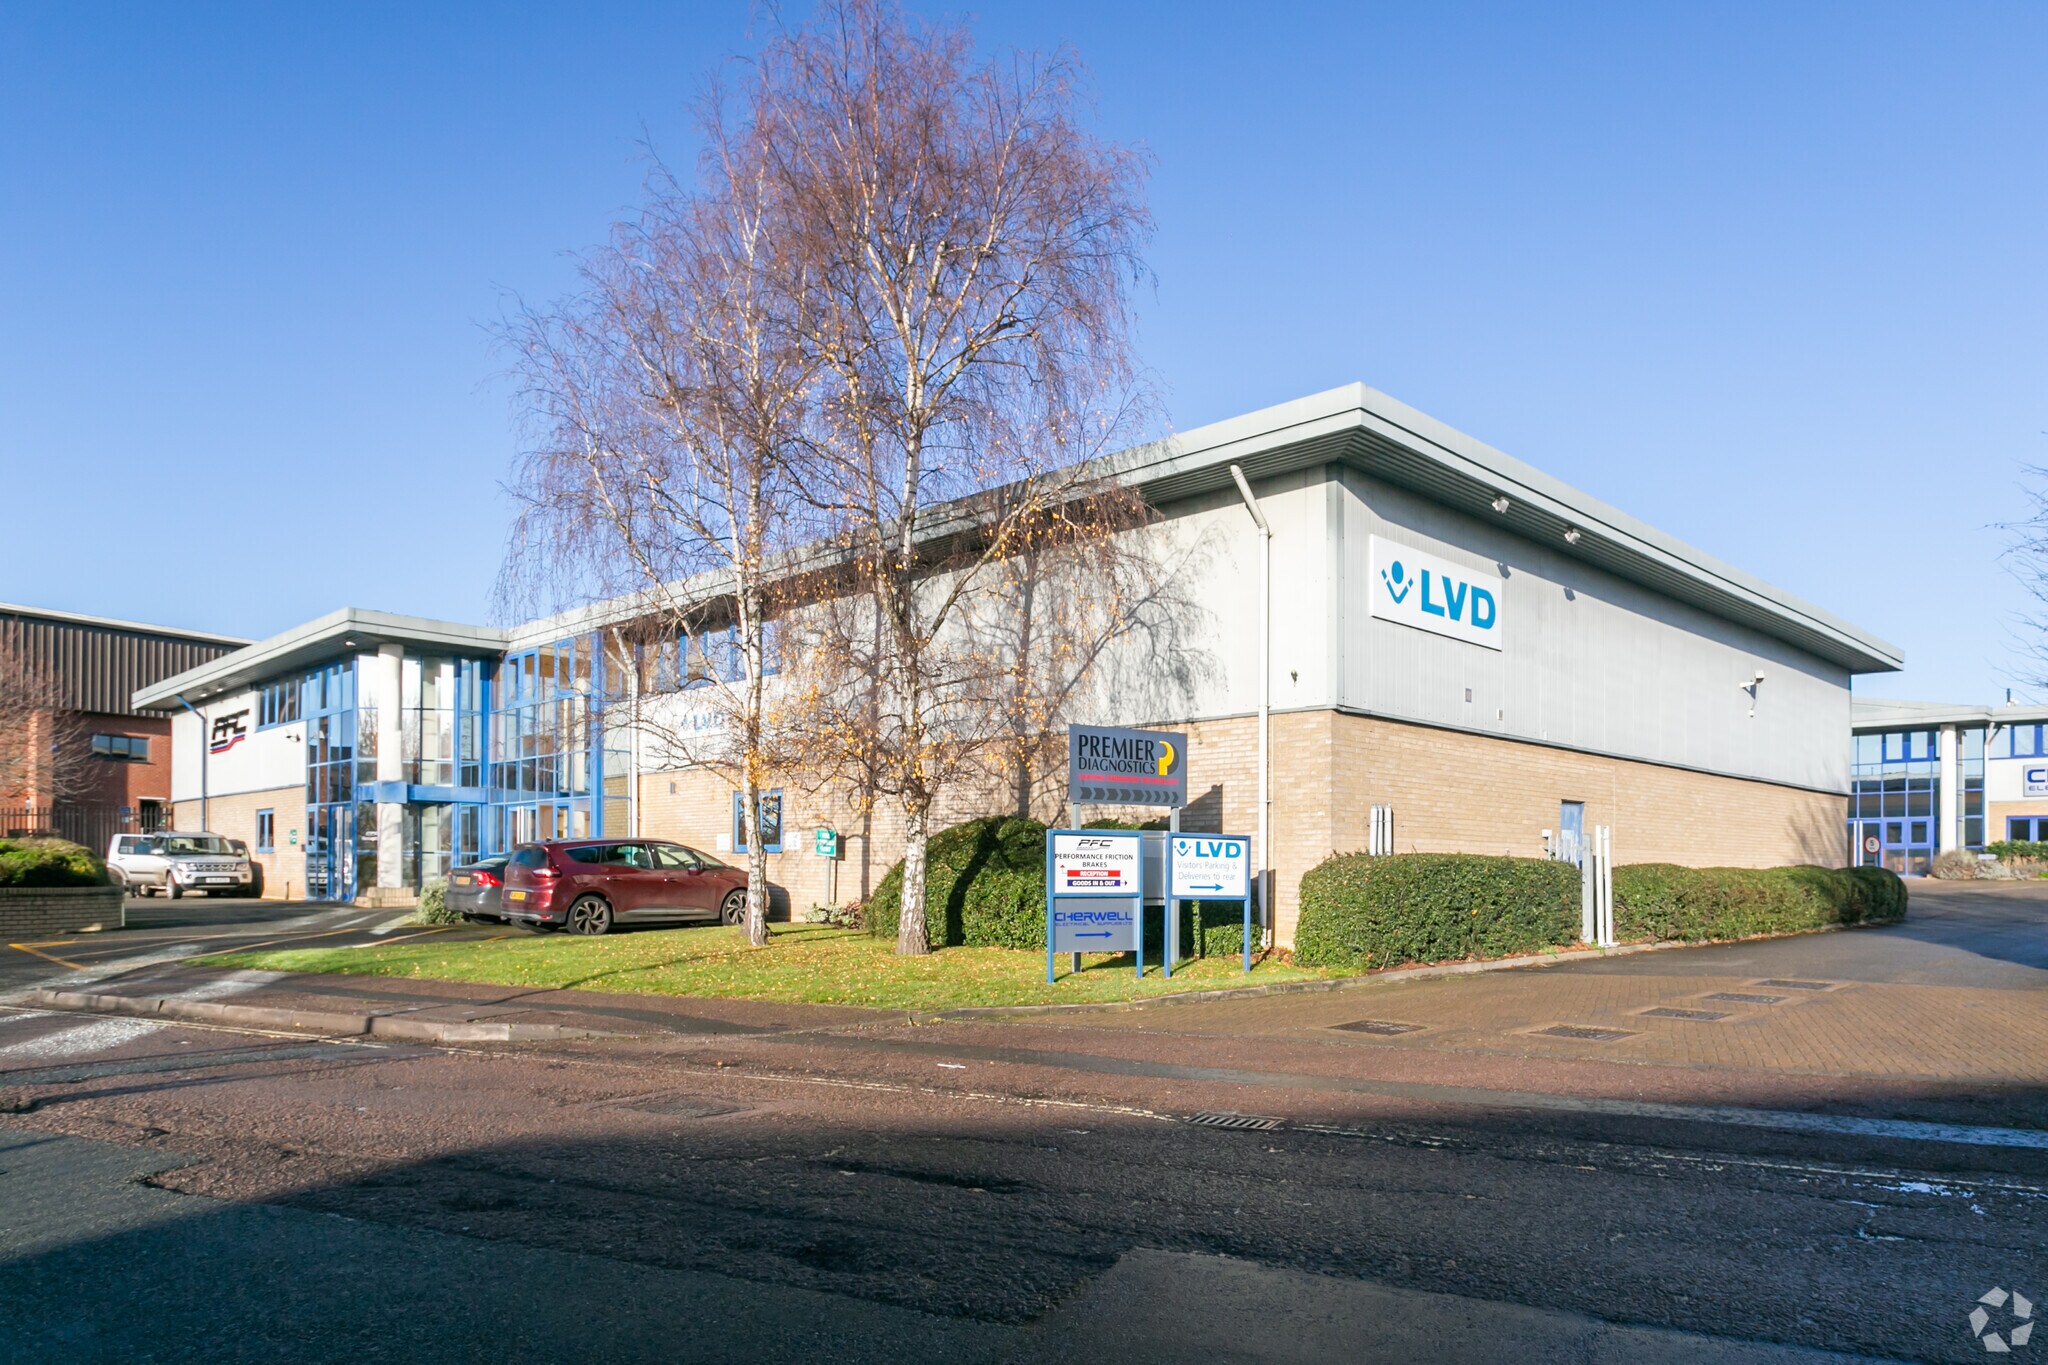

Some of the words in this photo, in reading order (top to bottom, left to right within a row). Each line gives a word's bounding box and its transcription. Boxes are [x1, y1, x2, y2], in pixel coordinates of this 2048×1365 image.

[1420, 568, 1497, 631] LVD
[212, 708, 250, 741] PFC
[1078, 733, 1155, 763] PREMIER
[1078, 757, 1156, 775] DIAGNOSTICS
[1078, 839, 1113, 847] PFC
[1195, 841, 1241, 858] LVD
[1105, 853, 1133, 861] FRICTION
[1177, 861, 1202, 869] Visitors
[1204, 861, 1230, 871] Parking
[1178, 872, 1211, 880] Deliveries
